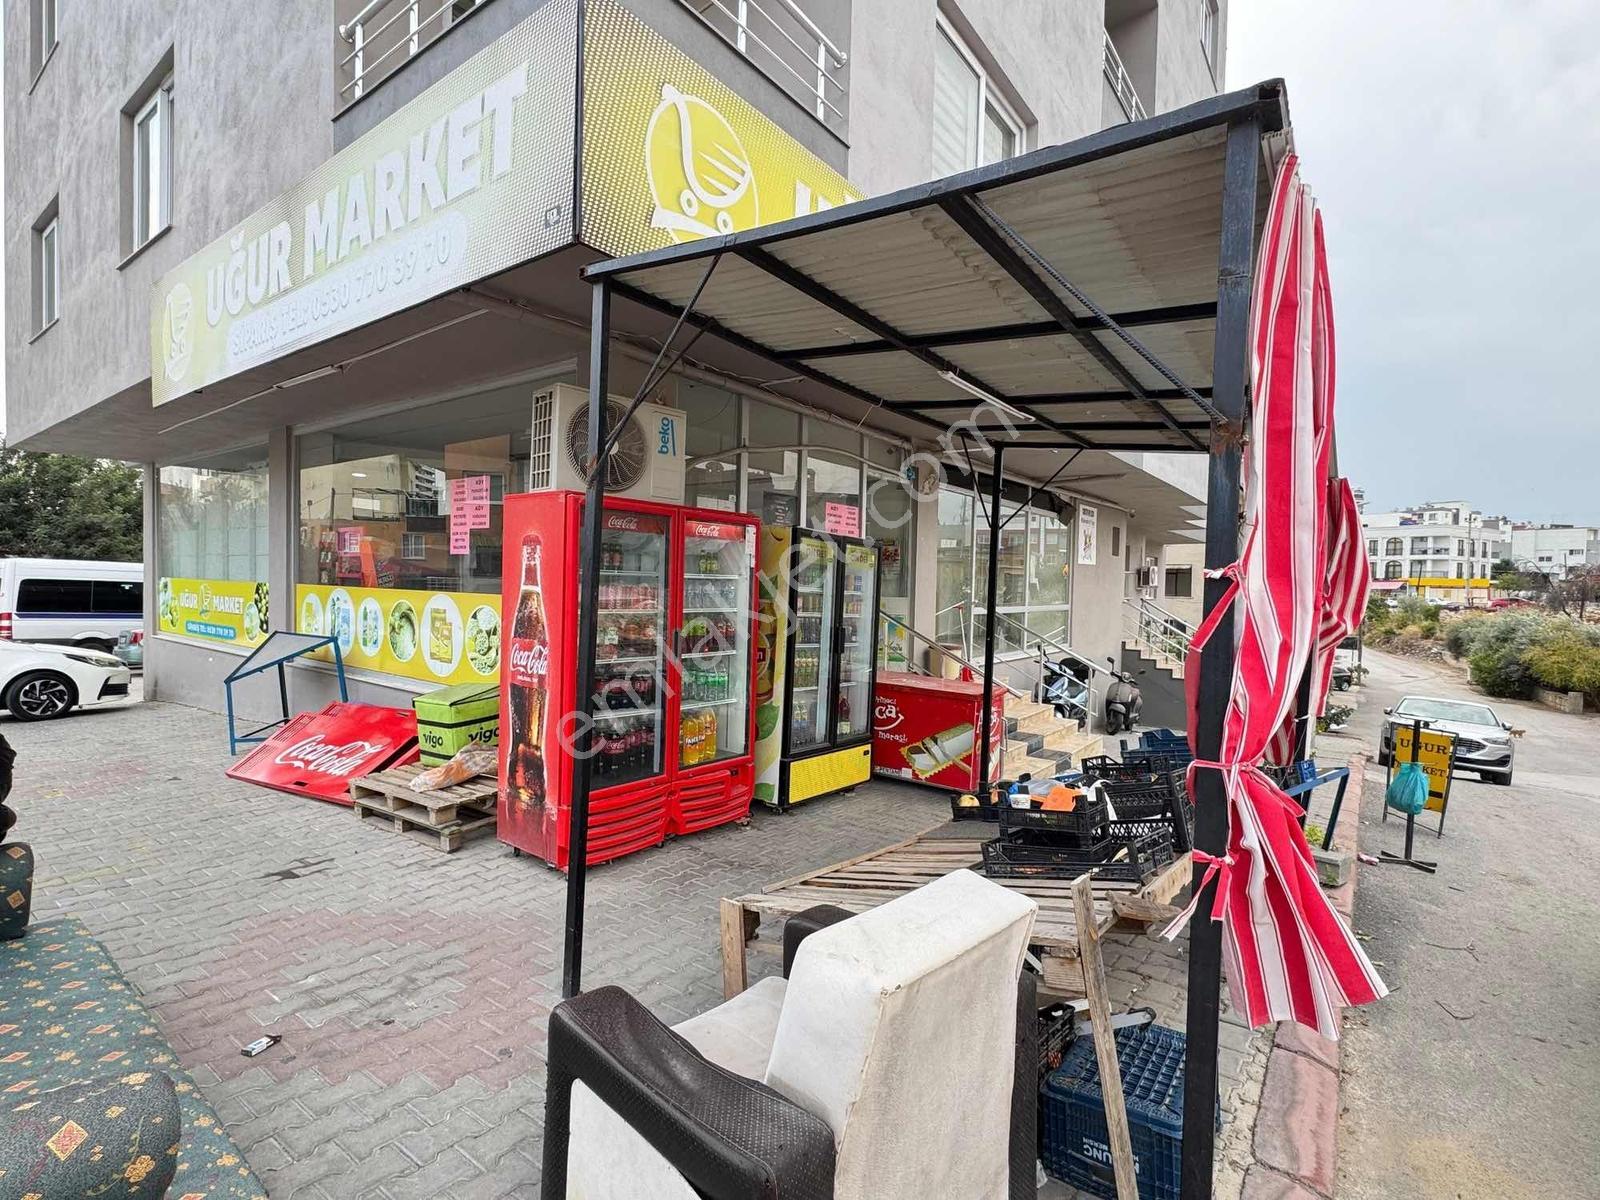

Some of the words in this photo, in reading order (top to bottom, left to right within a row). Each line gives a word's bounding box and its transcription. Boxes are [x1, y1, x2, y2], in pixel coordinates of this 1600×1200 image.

[205, 221, 292, 327] UĞUR
[303, 62, 529, 278] MARKET
[657, 417, 670, 456] beko
[180, 589, 198, 608] UĞUR
[213, 595, 244, 615] MARKET
[422, 731, 444, 748] vigo
[1400, 738, 1448, 755] UUR
